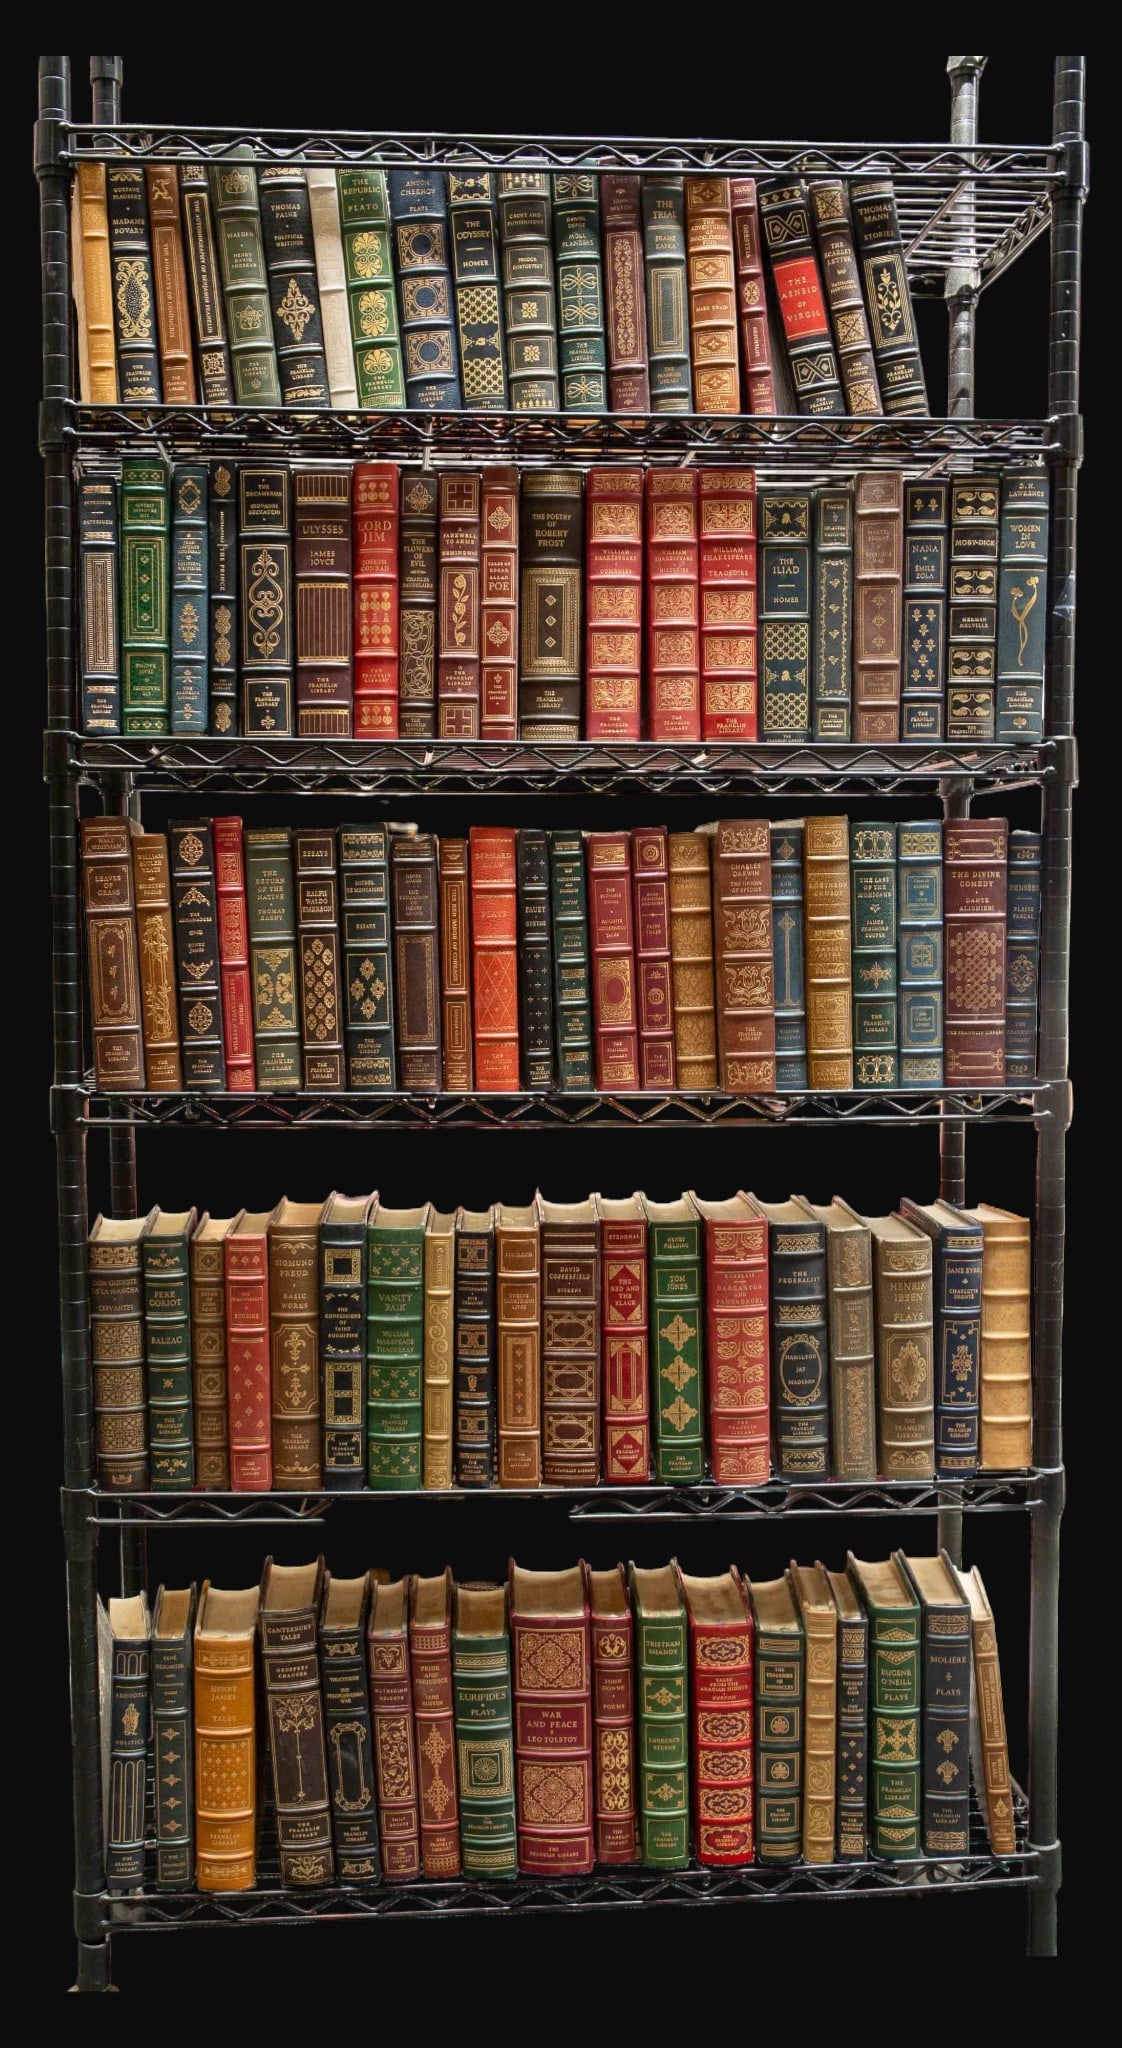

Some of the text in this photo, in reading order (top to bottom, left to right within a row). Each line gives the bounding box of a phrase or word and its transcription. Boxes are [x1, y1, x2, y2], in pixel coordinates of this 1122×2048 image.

[343, 186, 380, 194] REPUBLIC
[858, 204, 892, 215] THOMAS
[653, 211, 676, 219] TRIAL
[863, 214, 889, 222] MANN
[457, 230, 490, 240] ODYSSEY
[864, 231, 894, 240] STORIES
[781, 286, 817, 299] AENEID
[787, 310, 821, 322] VIRGIL
[303, 525, 343, 534] ULYSSES
[358, 521, 392, 531] LORD
[363, 532, 385, 544] JIM
[538, 539, 565, 547] FROST
[1015, 540, 1036, 548] LOVE
[912, 545, 938, 553] NANA
[773, 565, 799, 574] ILIAD
[488, 582, 509, 590] POE
[960, 880, 993, 888] COMEDY
[275, 1259, 313, 1267] SIGMUND
[280, 1269, 308, 1277] FREUD
[667, 1282, 688, 1290] JONES
[890, 1282, 927, 1291] HENRIK
[379, 1294, 412, 1302] VANITY
[895, 1293, 923, 1301] IBSEN
[150, 1299, 182, 1307] GORIOT
[385, 1303, 406, 1311] FAIR
[894, 1313, 923, 1322] PLAYS
[151, 1336, 182, 1344] BALZAC
[268, 1624, 312, 1634] CANTERBURY
[936, 1688, 961, 1696] PLAYS
[459, 1692, 506, 1701] EURIPIDES
